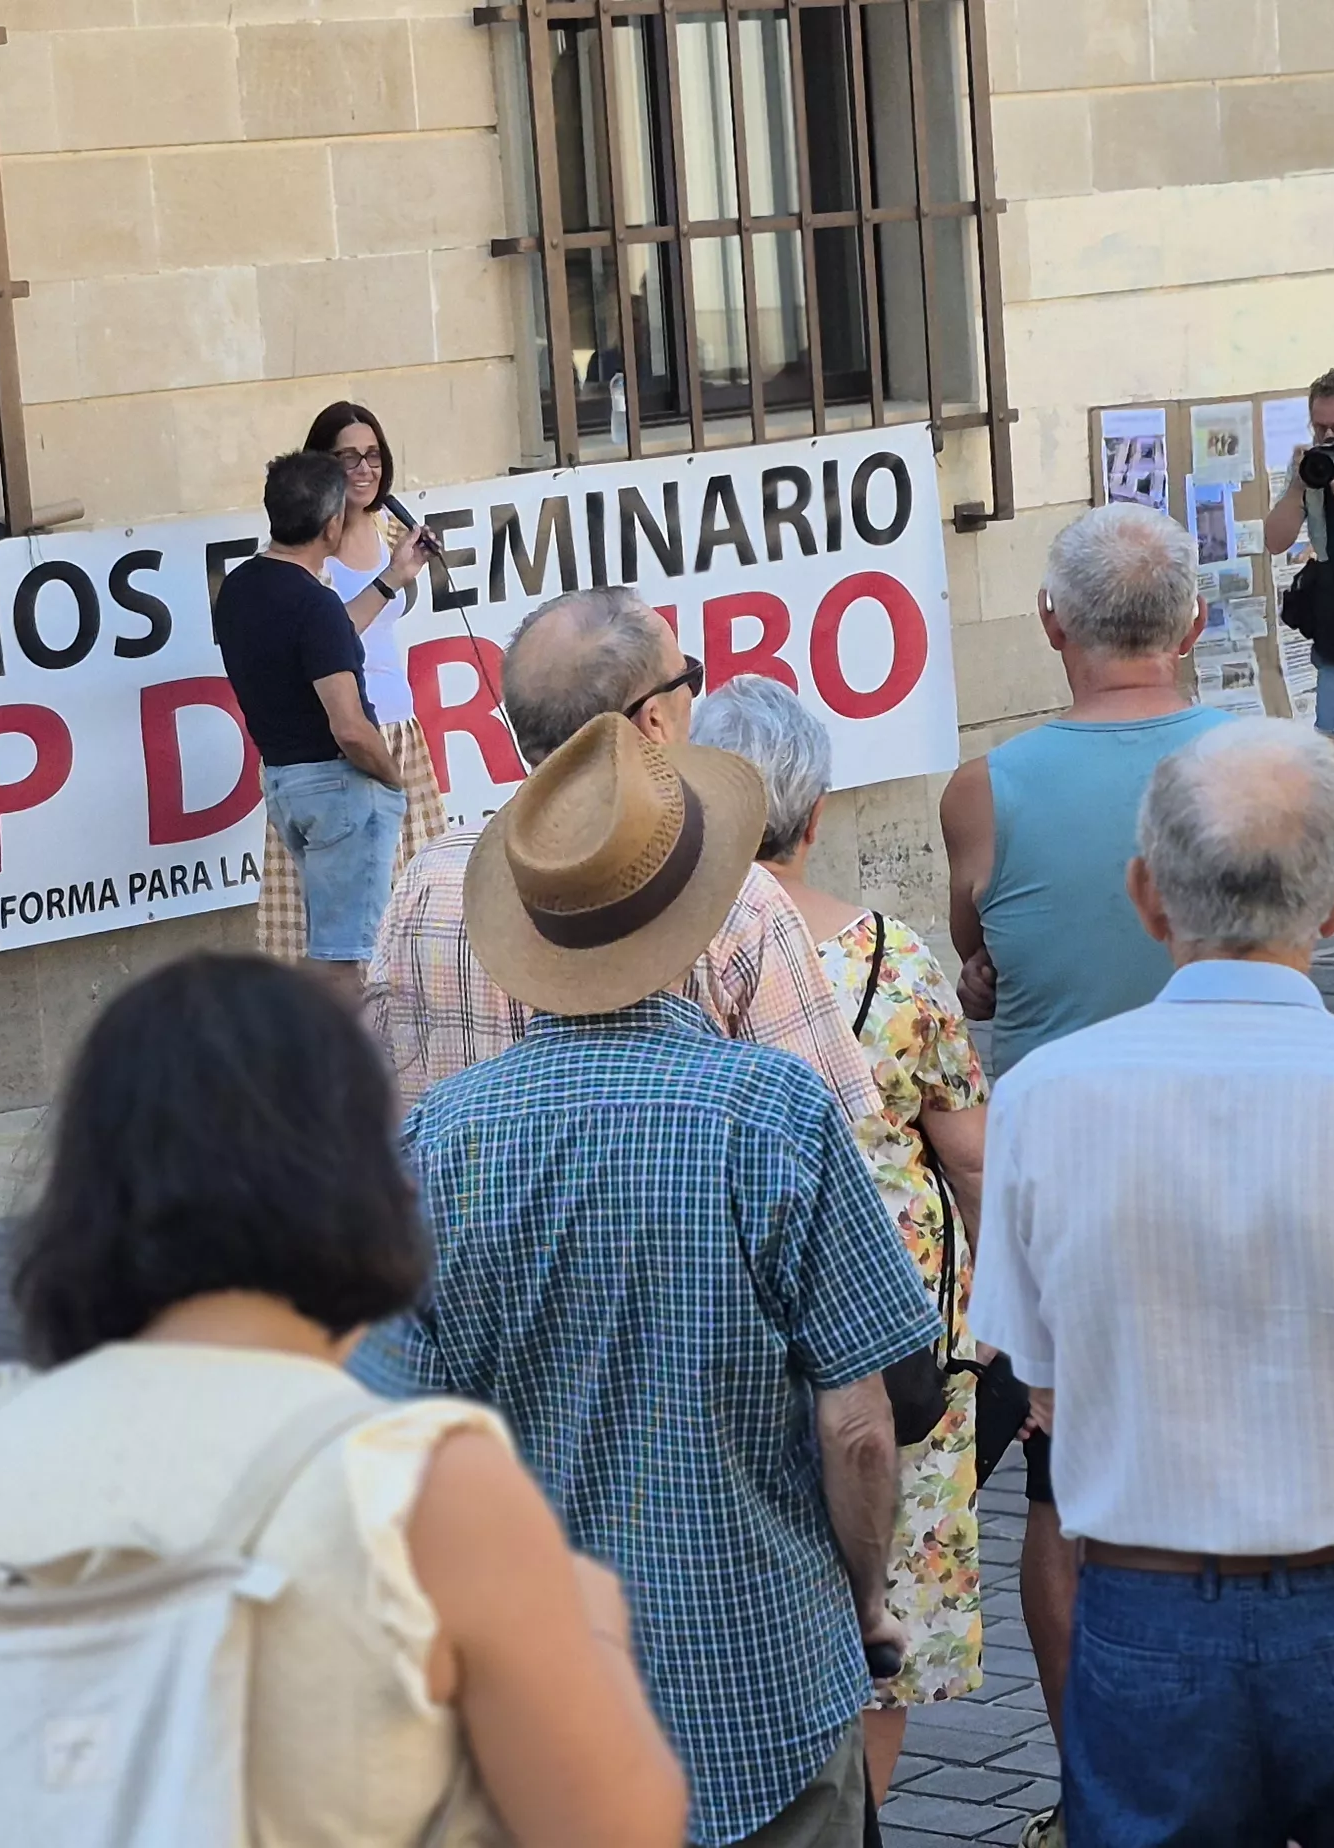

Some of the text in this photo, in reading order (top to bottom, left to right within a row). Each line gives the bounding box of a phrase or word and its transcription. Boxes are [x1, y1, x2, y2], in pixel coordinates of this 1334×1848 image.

[401, 451, 913, 616] EMINARIO
[129, 861, 213, 905] PARA
[221, 852, 260, 889] LA
